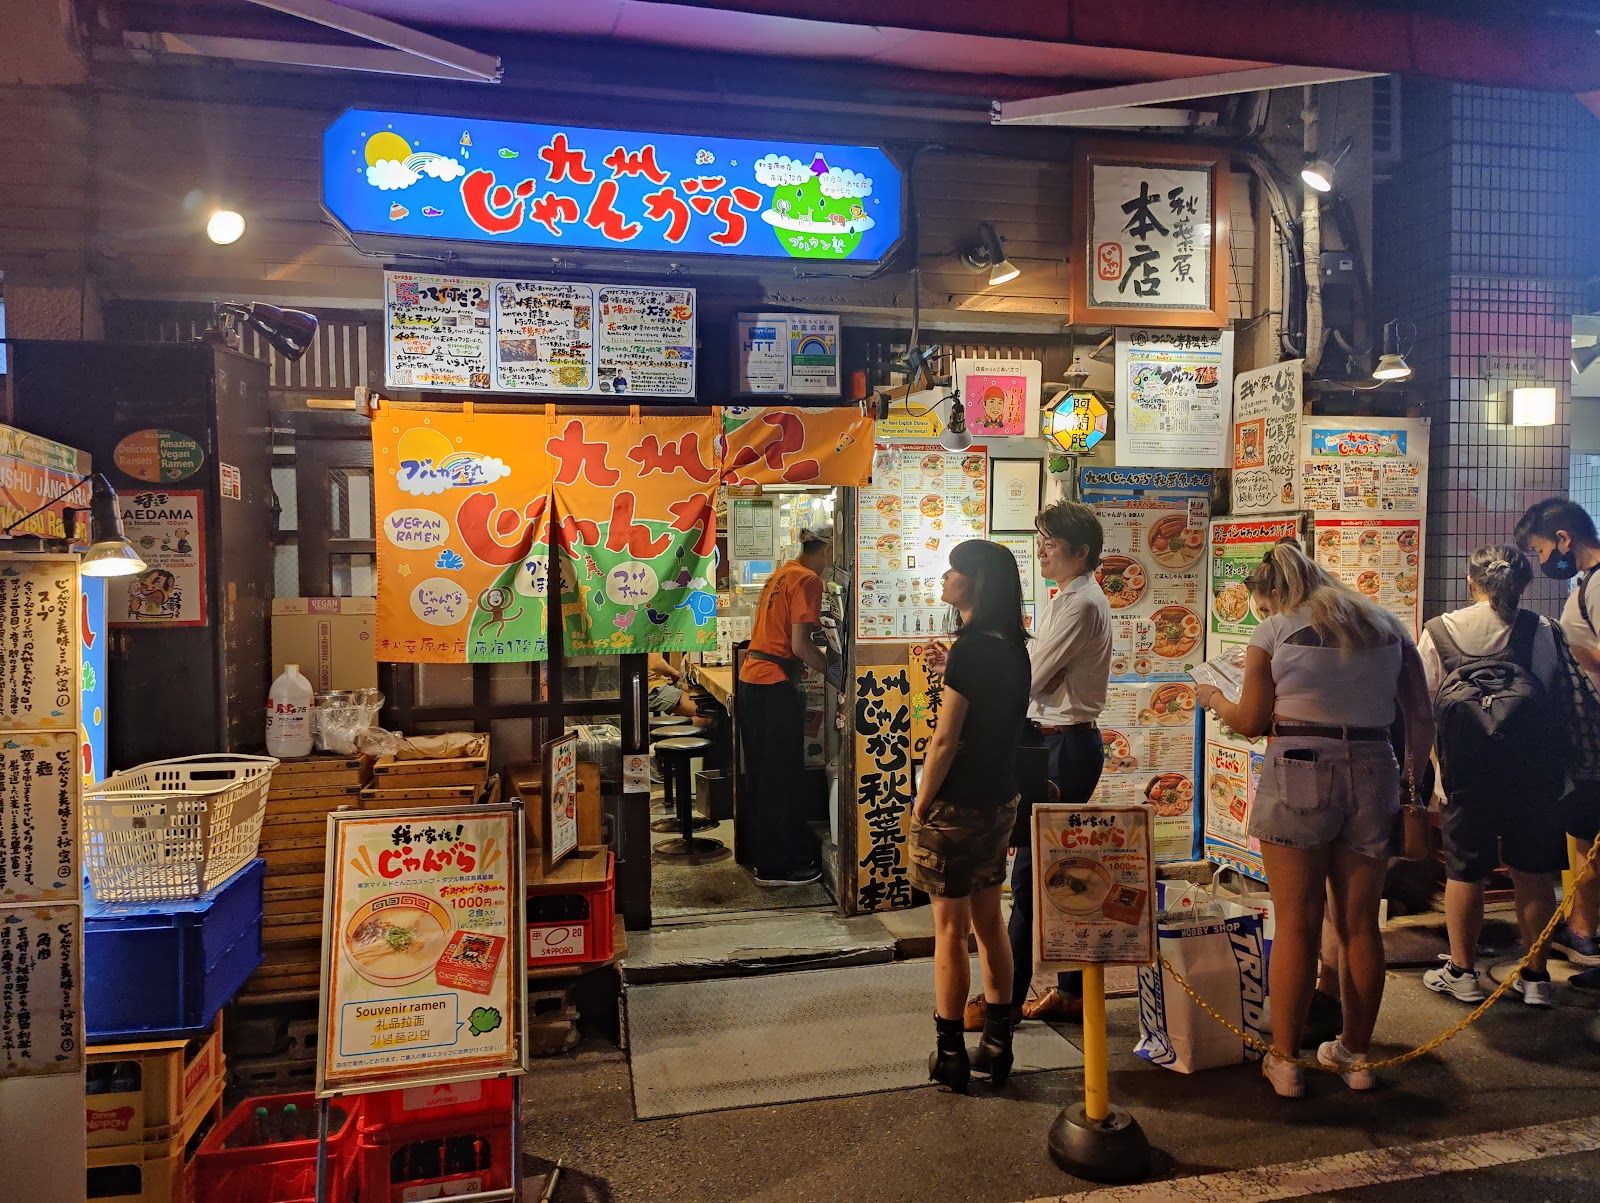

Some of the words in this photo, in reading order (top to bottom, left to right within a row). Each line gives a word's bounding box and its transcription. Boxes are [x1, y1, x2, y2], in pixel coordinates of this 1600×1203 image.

[538, 132, 668, 185] 九州
[460, 169, 762, 247] じゃんがら
[1117, 181, 1170, 298] 本店
[1167, 187, 1199, 284] 秋葉原
[743, 341, 774, 352] HTT
[160, 439, 196, 450] Amazing
[1347, 430, 1370, 442] 九州
[160, 450, 191, 461] Vegan
[545, 418, 720, 488] 九州
[1337, 441, 1382, 456] じゃんがら
[160, 459, 195, 468] Ramen
[400, 458, 488, 487] ブルカン塾
[1085, 471, 1152, 485] 九州じゃんがら
[1154, 472, 1212, 489] 秋葉原本店
[391, 516, 442, 529] VEGAN
[396, 530, 441, 543] RAMEN
[36, 590, 55, 622] スープ
[311, 599, 339, 607] VEGAN
[1060, 826, 1126, 849] じゃんがら
[378, 841, 477, 879] じゃんがら
[572, 927, 582, 938] 20
[1181, 926, 1209, 938] HOBBY
[1213, 922, 1241, 933] SHOP
[356, 1003, 407, 1018] Souvenir
[410, 1000, 447, 1013] ramen
[375, 1014, 425, 1030] 礼品拉面
[368, 1029, 431, 1047] 기념품라면
